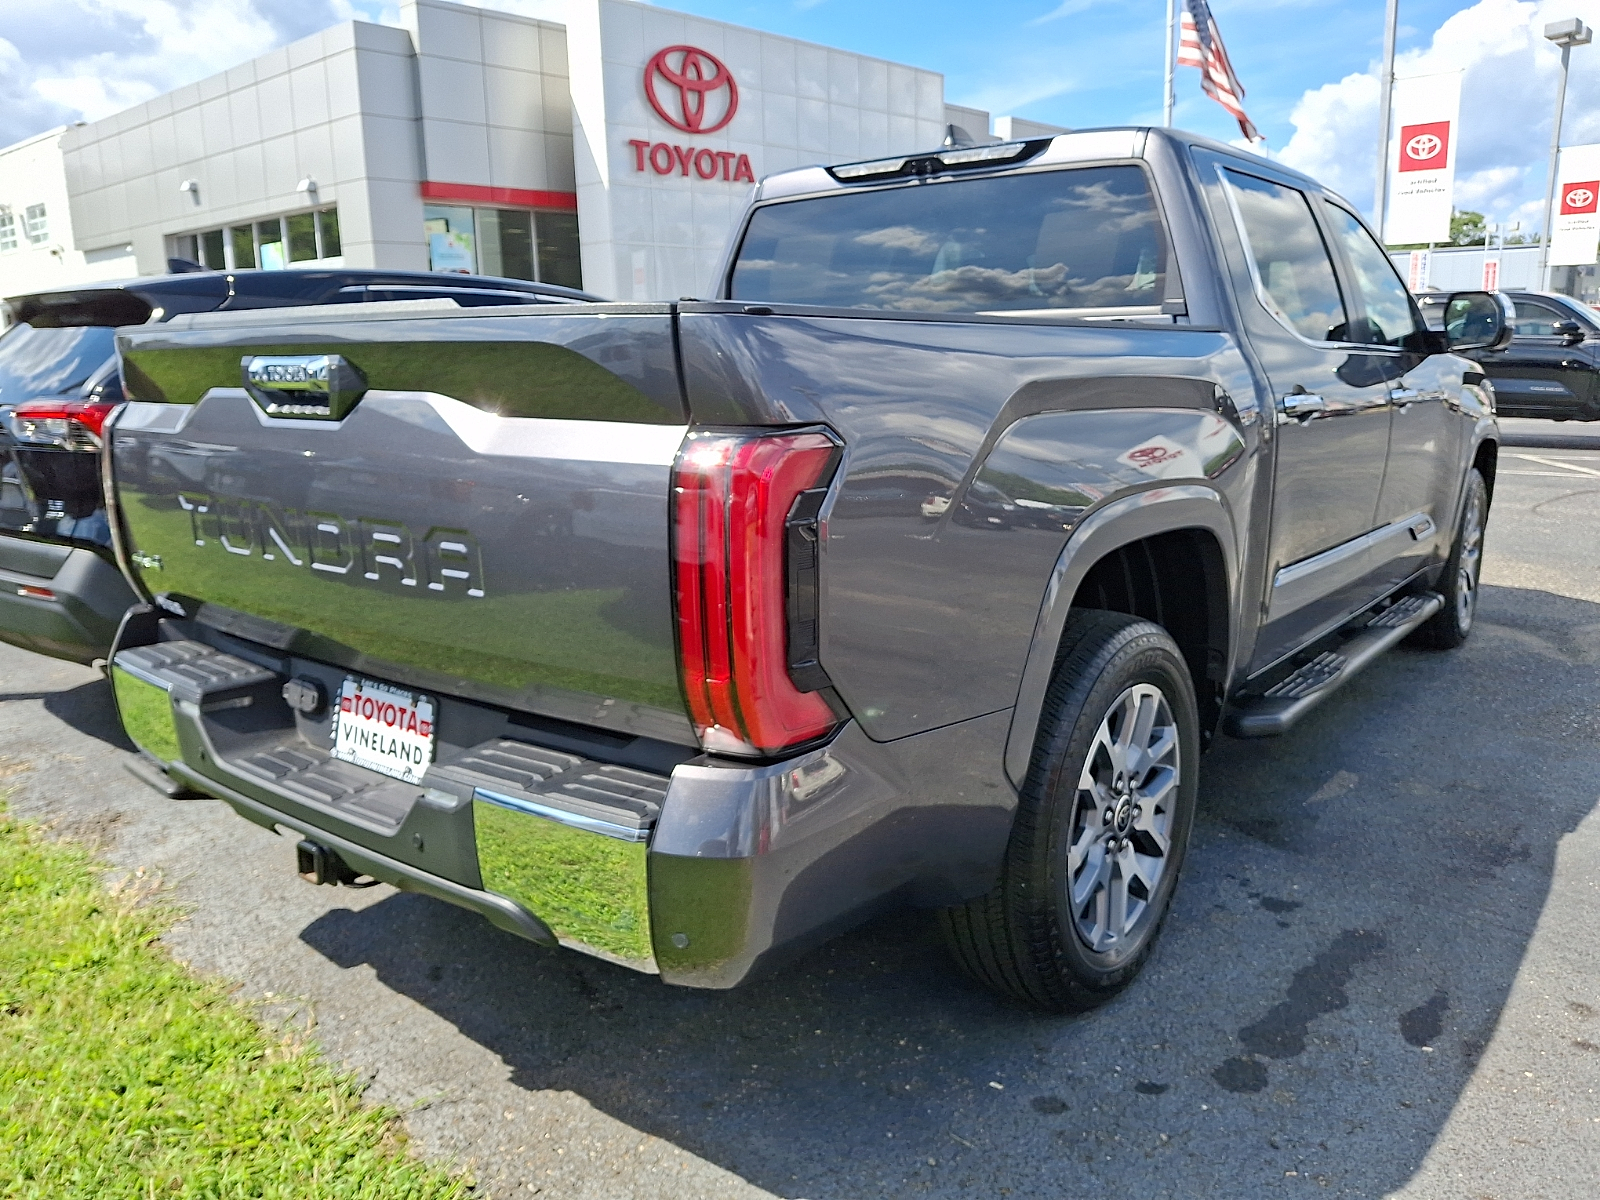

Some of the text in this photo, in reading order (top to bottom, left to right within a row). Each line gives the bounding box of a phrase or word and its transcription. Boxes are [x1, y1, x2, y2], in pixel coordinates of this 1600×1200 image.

[628, 139, 755, 183] TOYOTA
[178, 491, 486, 598] TUNDRA
[354, 694, 418, 736] TOYOTA
[343, 722, 423, 765] VINELAND
